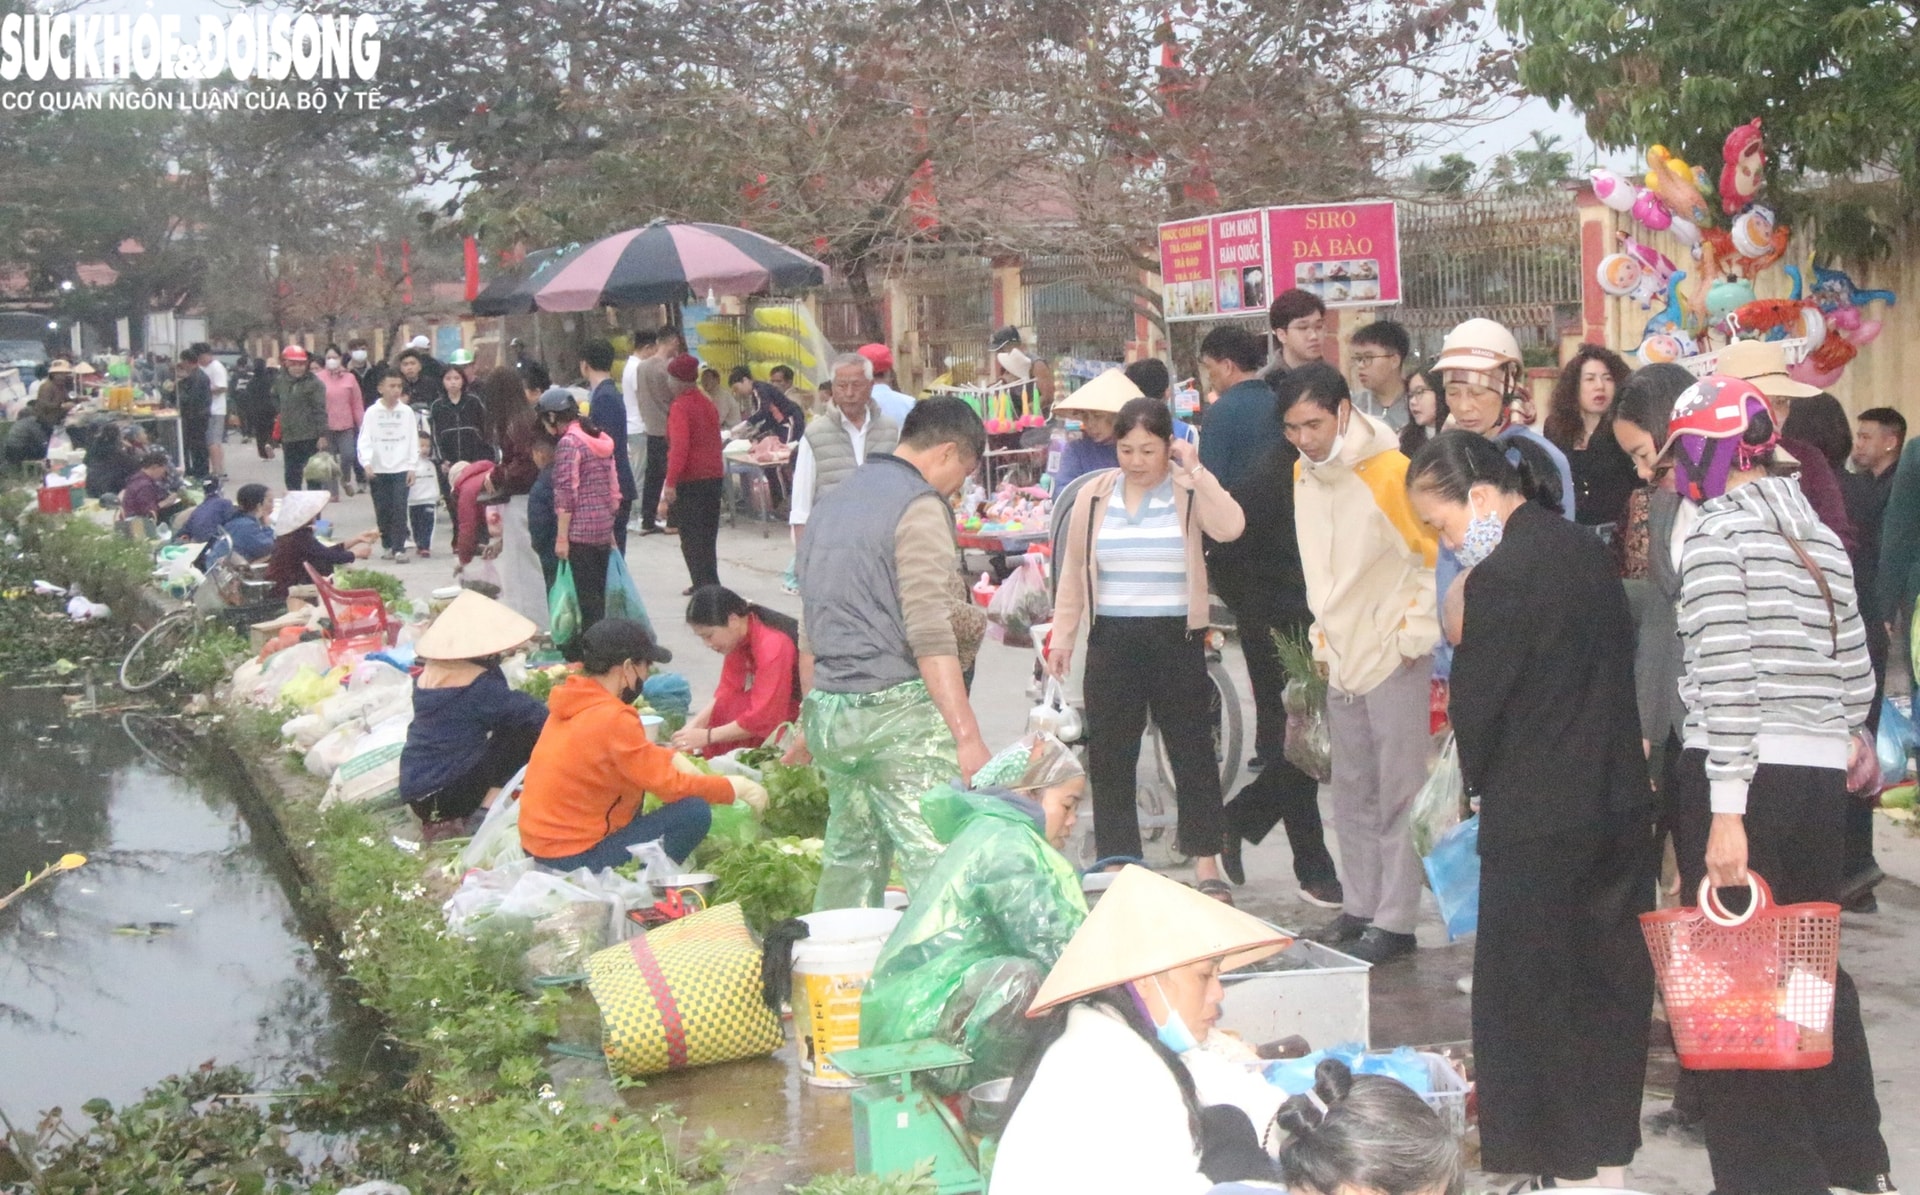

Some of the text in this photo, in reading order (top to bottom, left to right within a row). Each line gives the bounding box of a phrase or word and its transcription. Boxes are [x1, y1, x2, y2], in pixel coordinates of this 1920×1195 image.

[1220, 220, 1236, 239] KEM
[1305, 210, 1356, 230] SIRO
[1292, 233, 1373, 258] ĐÁ BÀO
